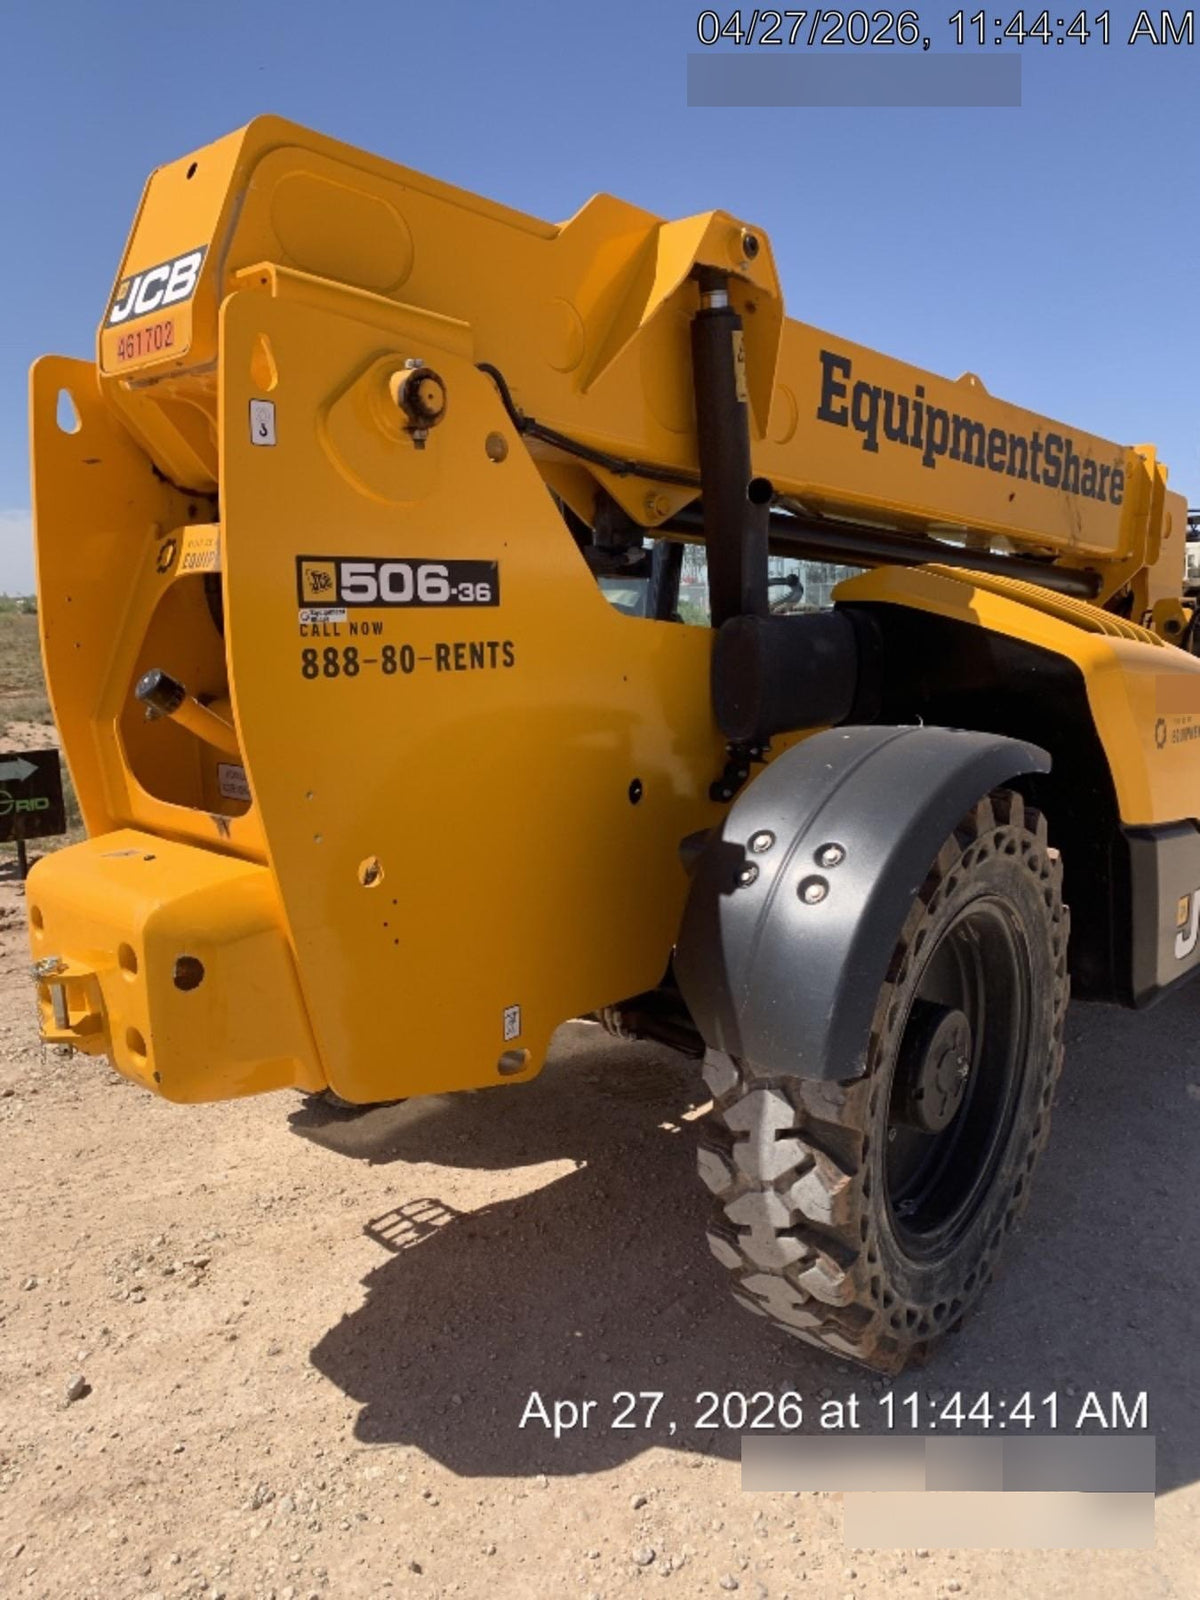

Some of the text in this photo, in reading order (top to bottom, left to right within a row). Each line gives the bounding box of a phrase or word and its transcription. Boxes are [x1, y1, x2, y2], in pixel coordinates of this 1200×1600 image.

[110, 252, 202, 323] JCB
[117, 321, 173, 360] 461702
[817, 350, 1124, 505] EquipmentShare
[340, 562, 492, 603] 506-36
[300, 622, 383, 637] CALL NOW
[302, 641, 515, 679] 888-80-RENTS
